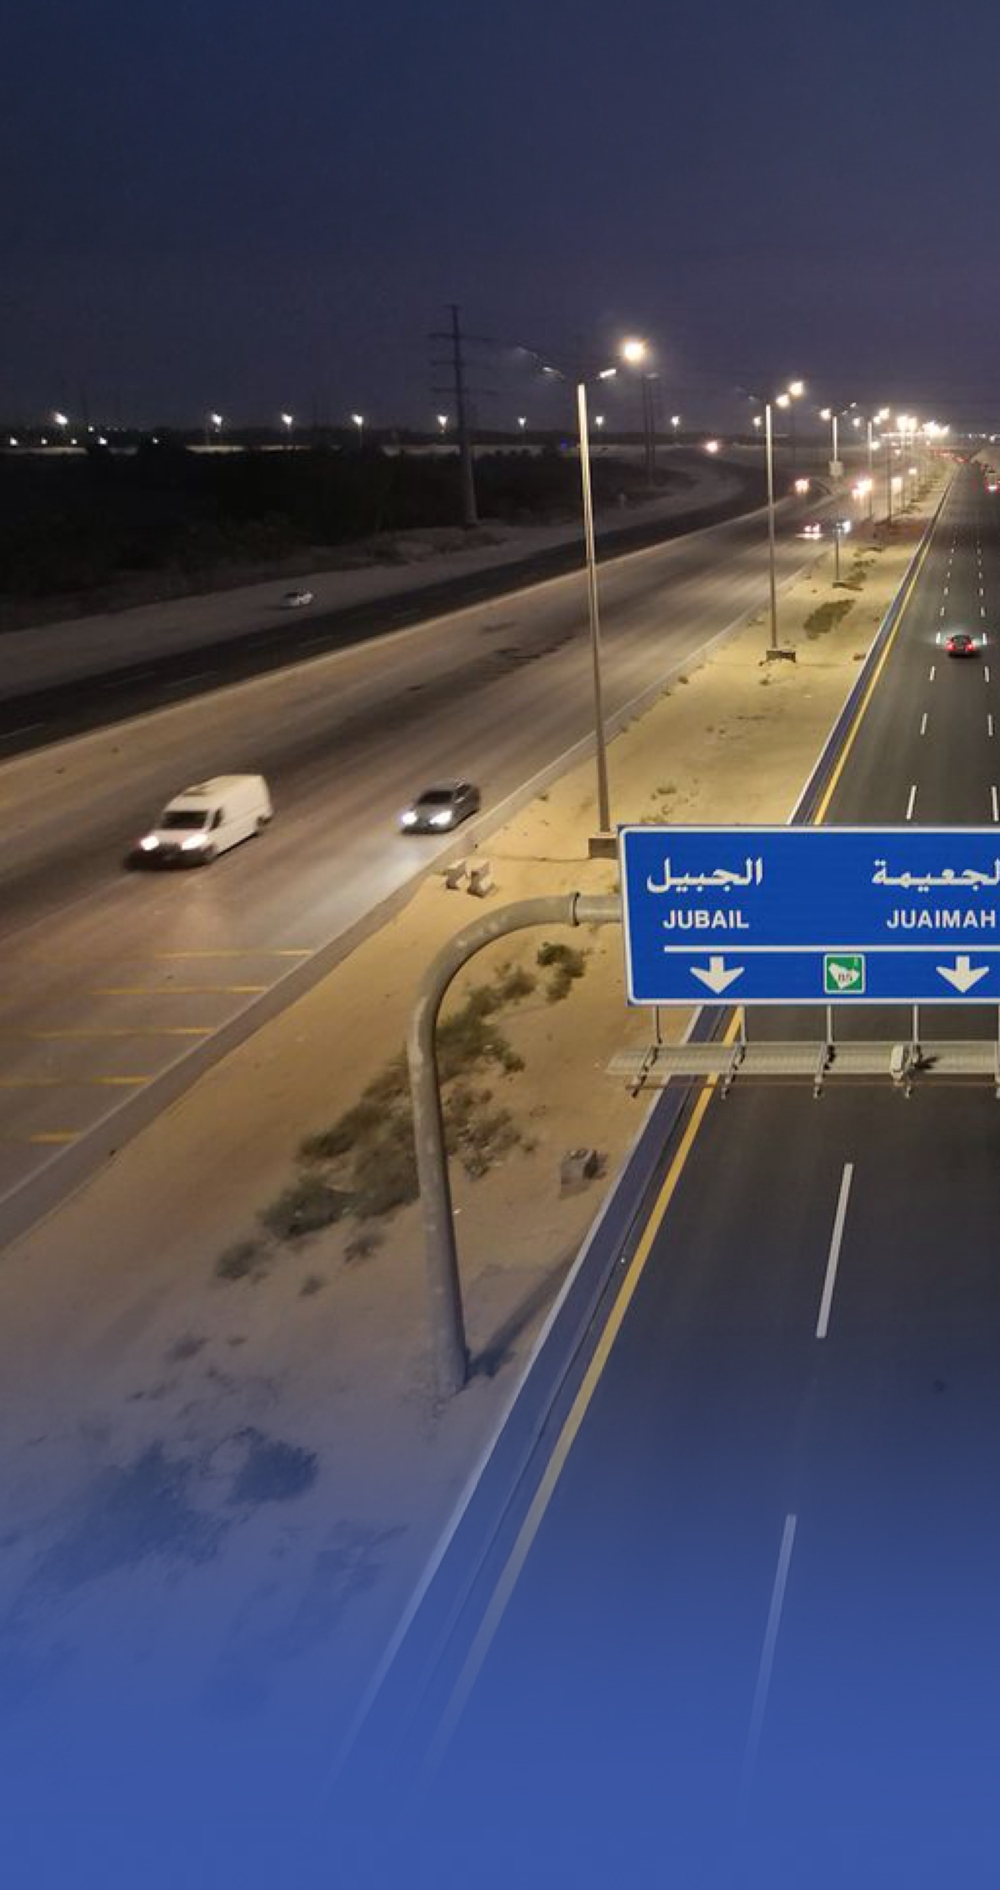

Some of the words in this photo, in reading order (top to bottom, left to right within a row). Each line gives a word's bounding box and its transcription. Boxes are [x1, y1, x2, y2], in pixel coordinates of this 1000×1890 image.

[646, 857, 763, 893] الجبيل
[663, 909, 750, 929] JUBAIL
[886, 909, 996, 929] JUAIMAH
